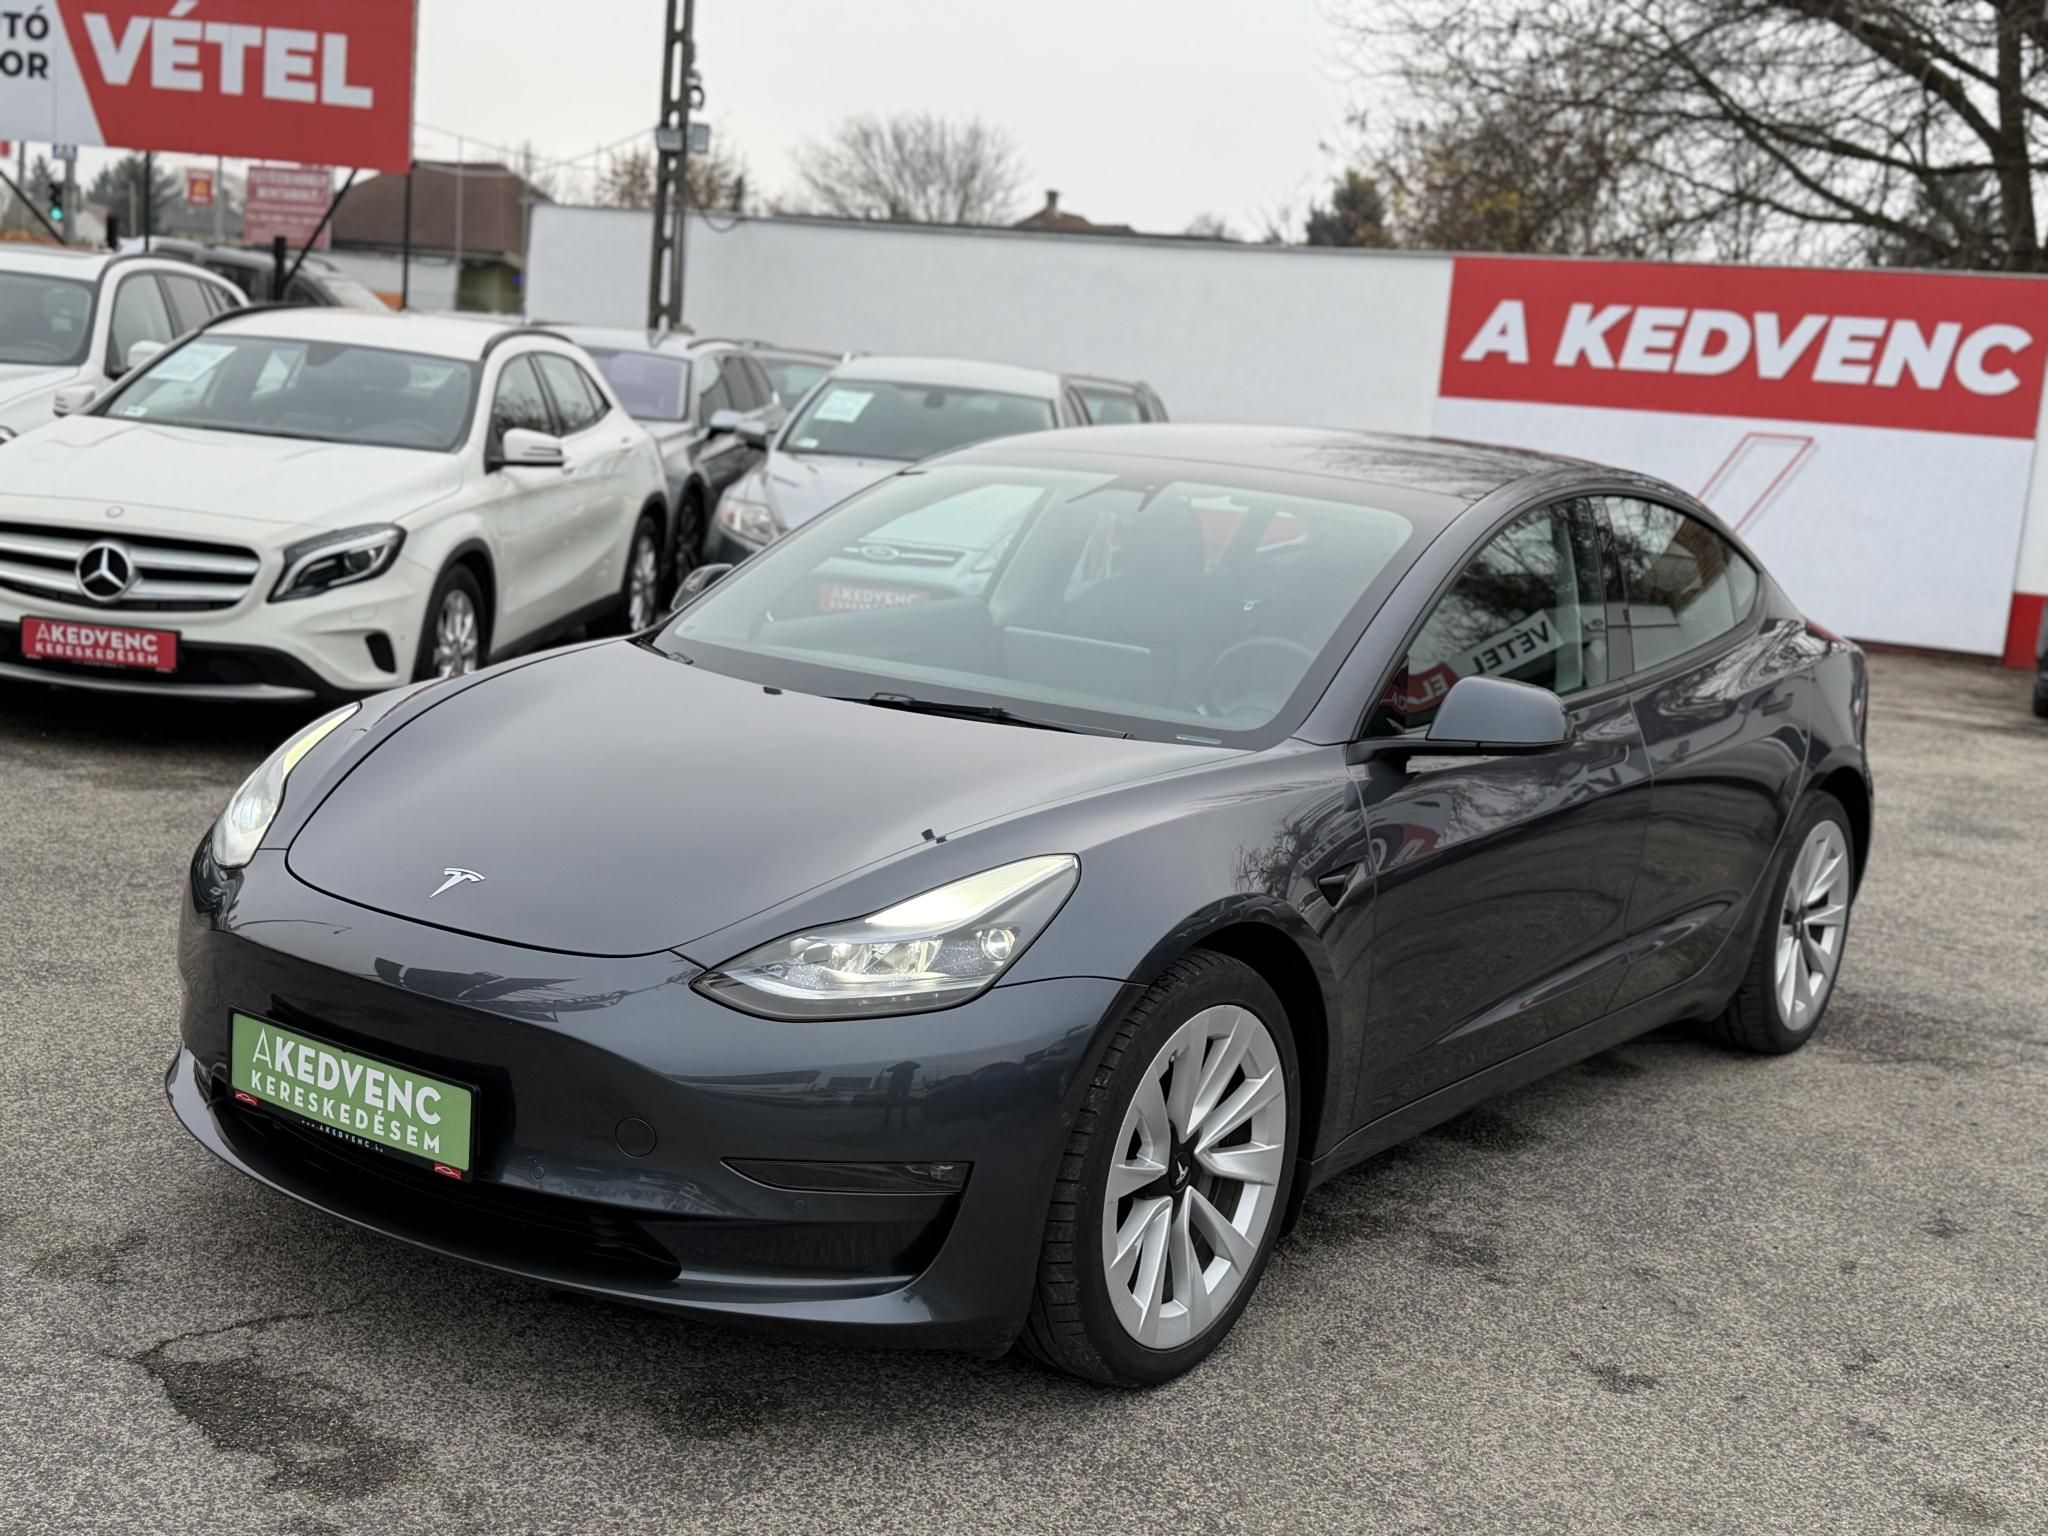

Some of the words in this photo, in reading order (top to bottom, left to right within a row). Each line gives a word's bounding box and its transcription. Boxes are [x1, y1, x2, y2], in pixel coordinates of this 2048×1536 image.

[82, 0, 374, 109] VÉTEL
[1460, 299, 1530, 365] A
[1552, 302, 2034, 396] KEDVENC
[250, 1069, 441, 1155] KERESKEDÉSEM
